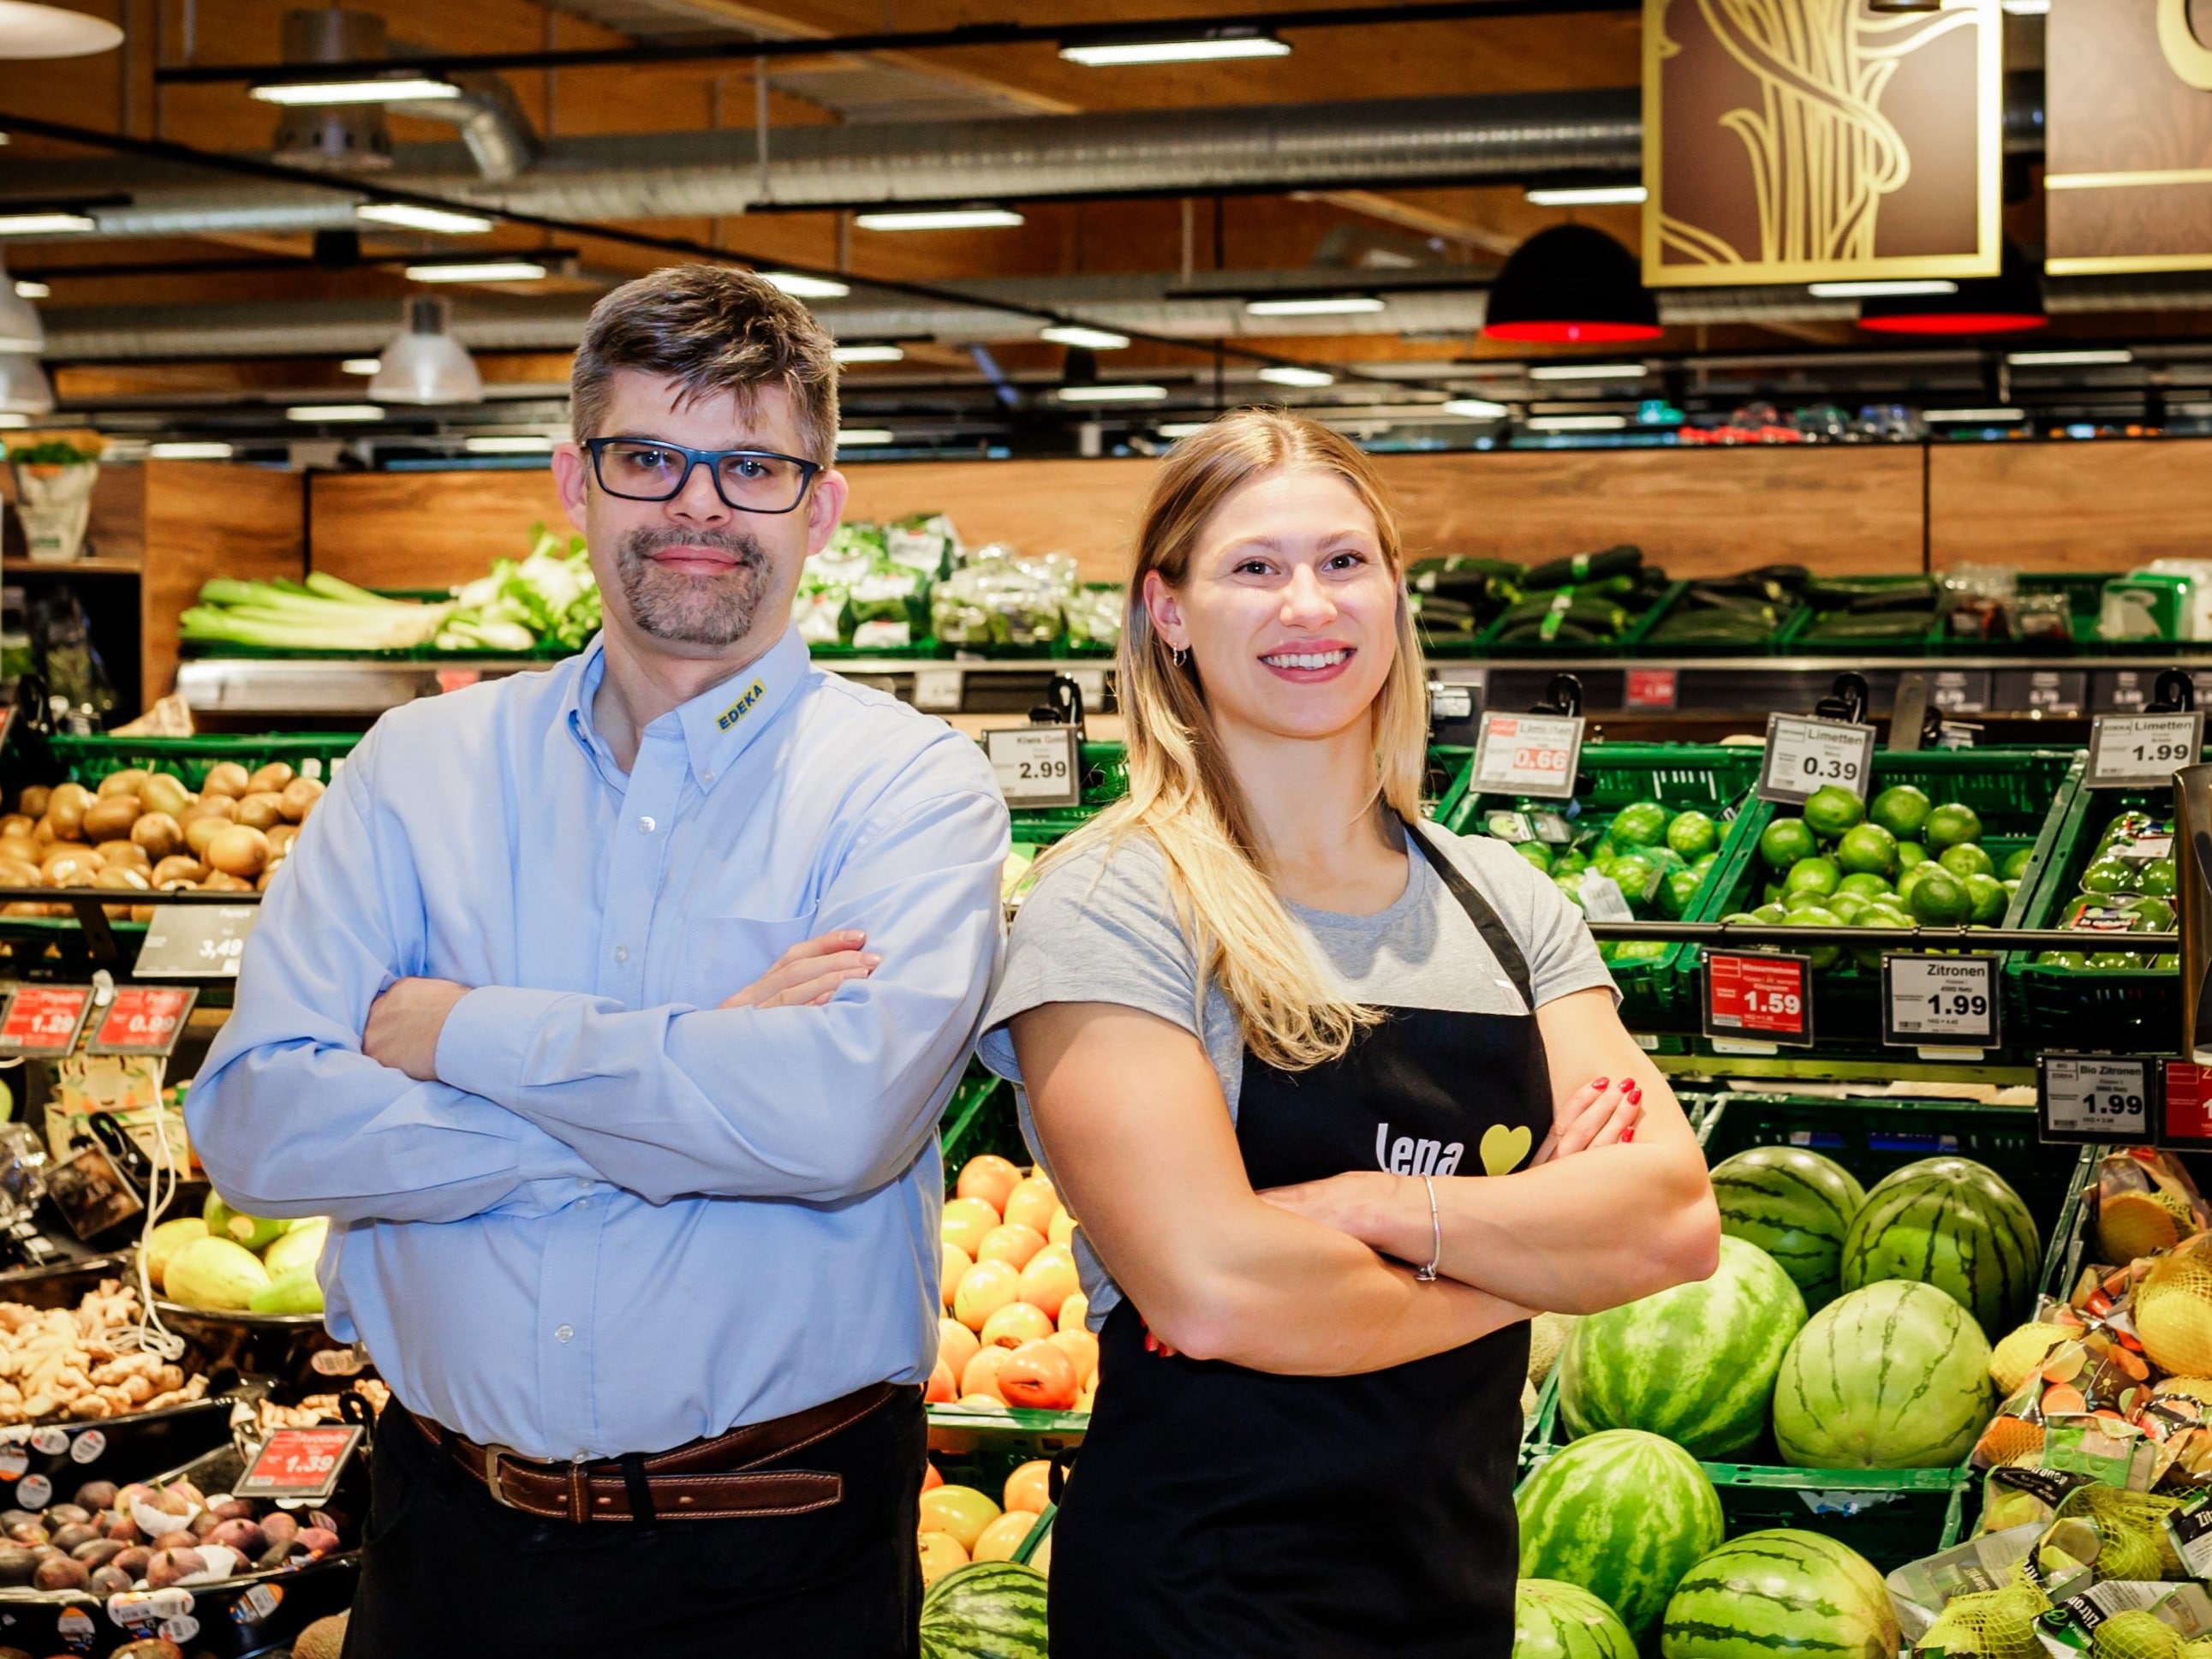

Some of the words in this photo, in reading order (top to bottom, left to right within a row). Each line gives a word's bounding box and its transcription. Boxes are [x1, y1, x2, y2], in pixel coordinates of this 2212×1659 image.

[718, 685, 763, 730] EDEKA
[2135, 721, 2192, 731] Limetten
[1808, 729, 1863, 745] Limetten
[1515, 749, 1567, 769] 0.66
[2132, 744, 2189, 761] 1.99
[1019, 761, 1067, 779] 2.99
[1804, 757, 1857, 780] 0.39
[1927, 964, 1985, 976] Zitronen
[1744, 990, 1801, 1015] 1.59
[1928, 994, 1987, 1016] 1.99
[2080, 1065, 2097, 1074] Bio
[2099, 1066, 2142, 1076] Zitronen
[2083, 1093, 2143, 1115] 1.99
